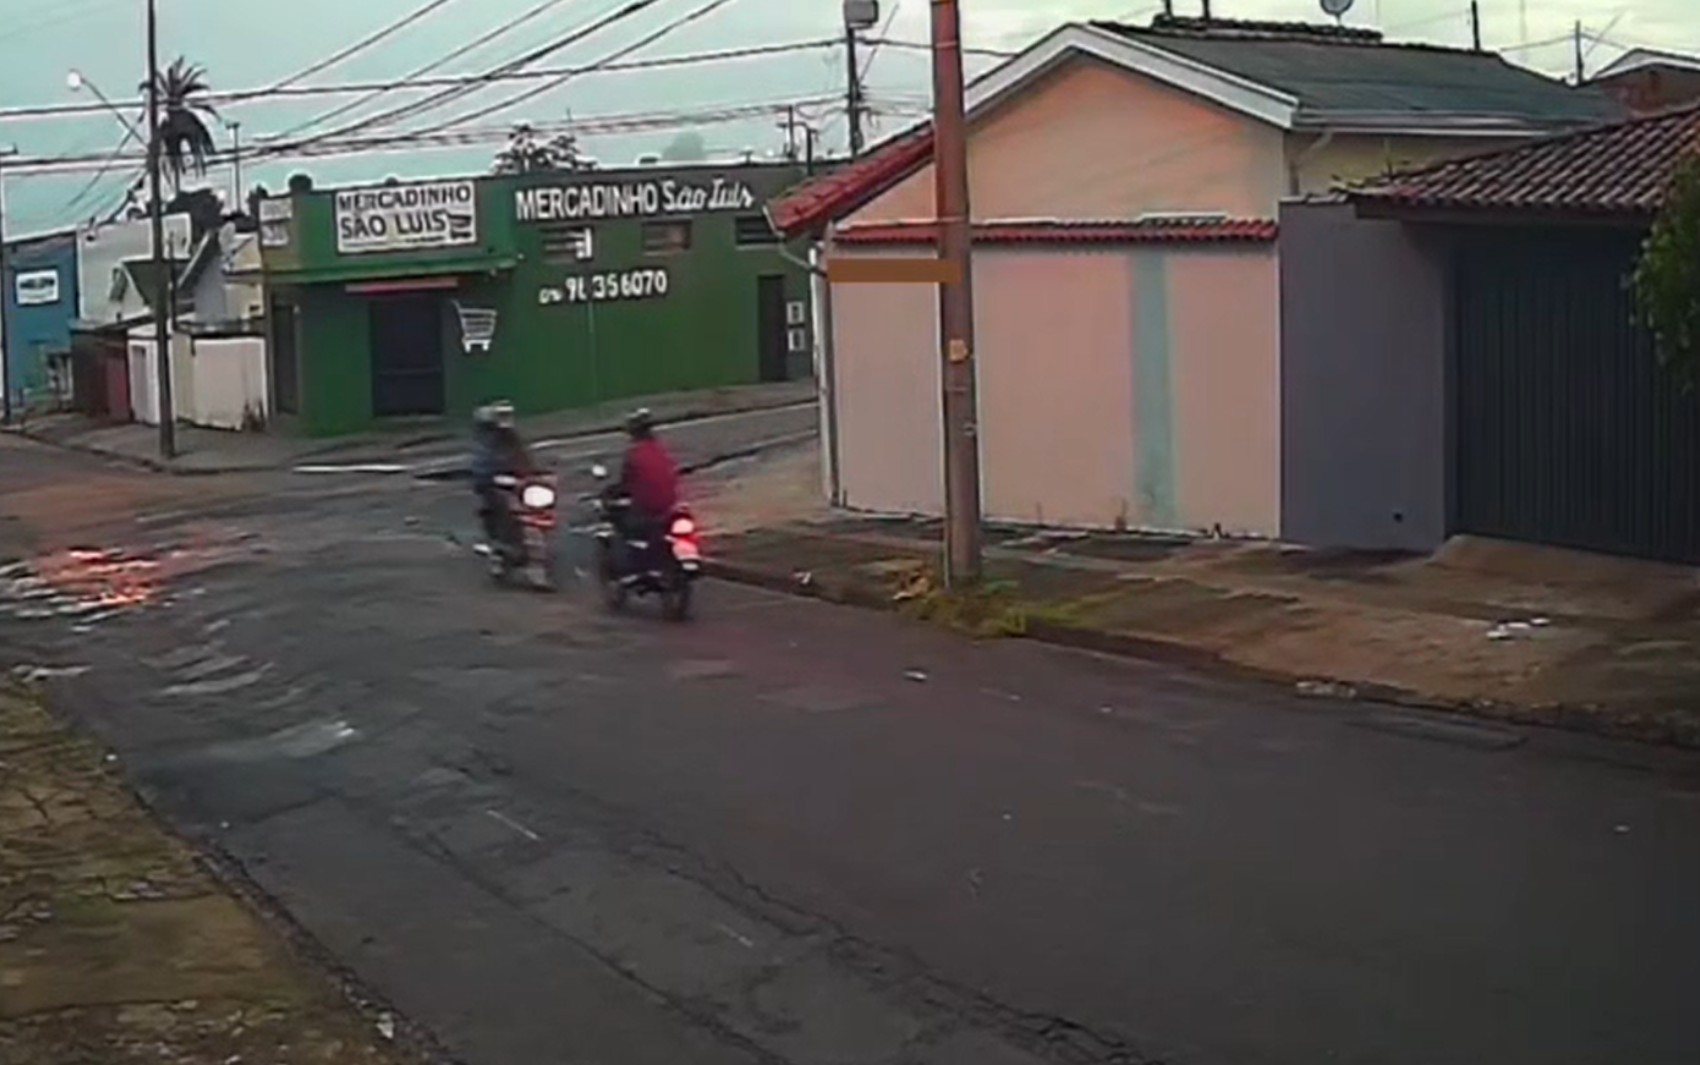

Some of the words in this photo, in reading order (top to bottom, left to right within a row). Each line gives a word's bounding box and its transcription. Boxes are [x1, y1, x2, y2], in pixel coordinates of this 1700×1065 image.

[339, 184, 471, 211] MERCADINHO
[516, 184, 657, 219] MERCADINHO
[395, 209, 446, 235] LUIS
